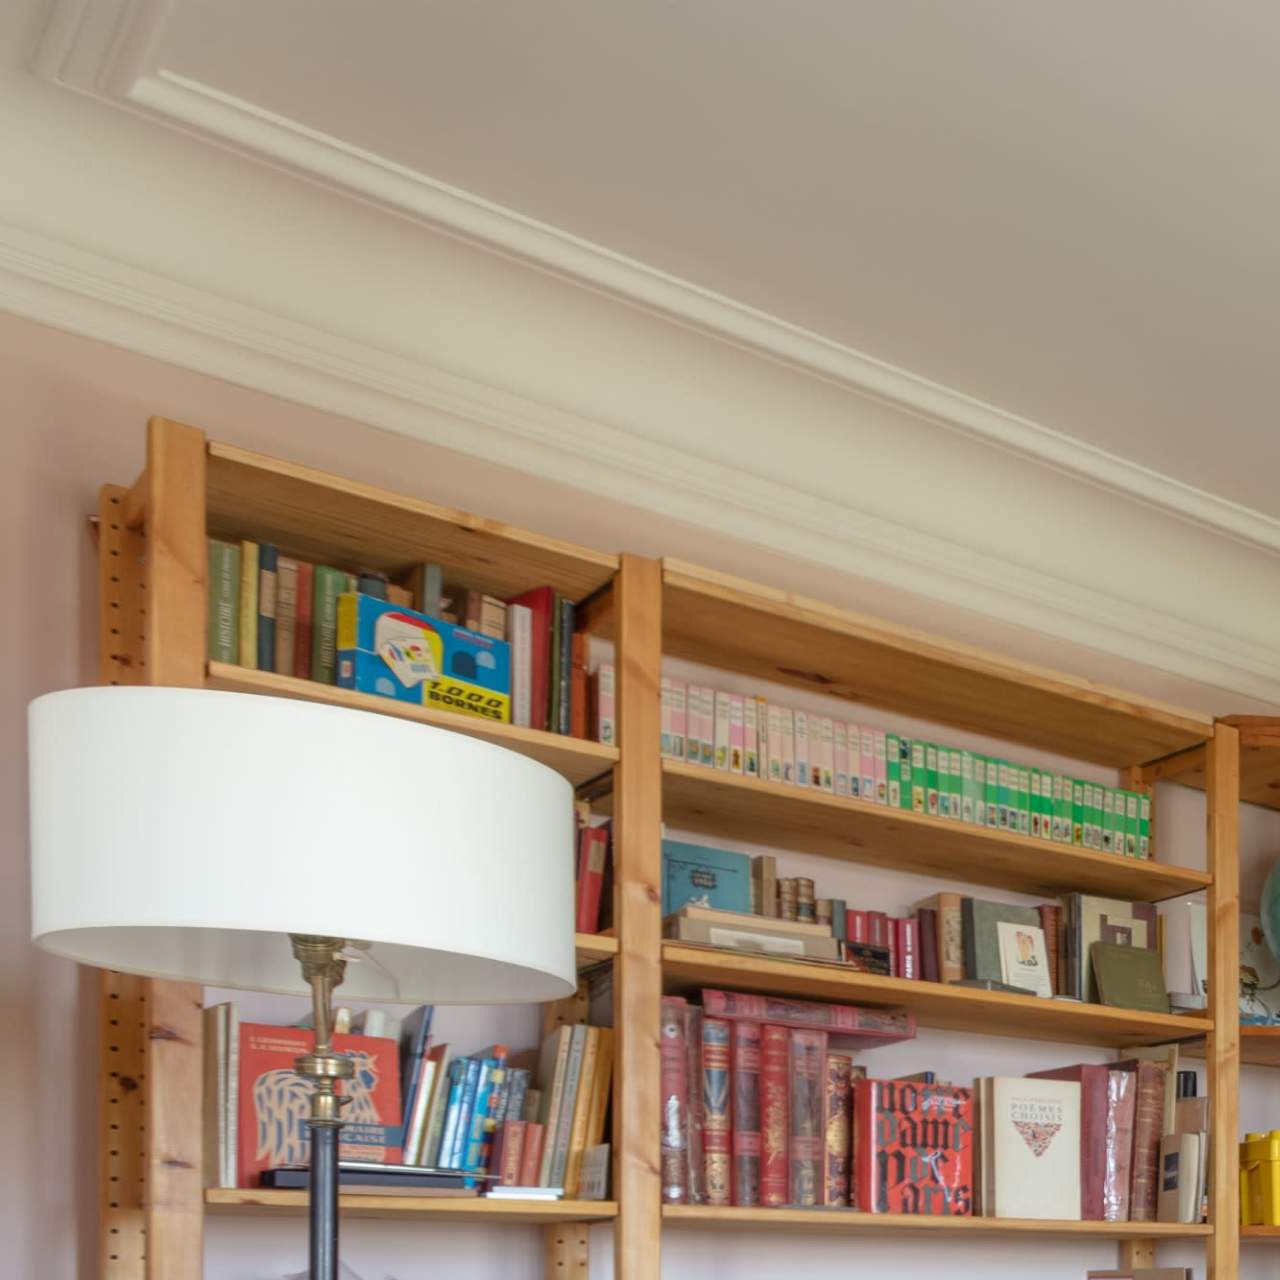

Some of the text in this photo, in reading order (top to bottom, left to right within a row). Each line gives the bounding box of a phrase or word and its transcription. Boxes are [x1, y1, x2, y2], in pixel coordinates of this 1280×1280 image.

[428, 691, 503, 721] BORNES
[1011, 1103, 1063, 1113] POÈMES
[1012, 1112, 1063, 1121] CHOISIS
